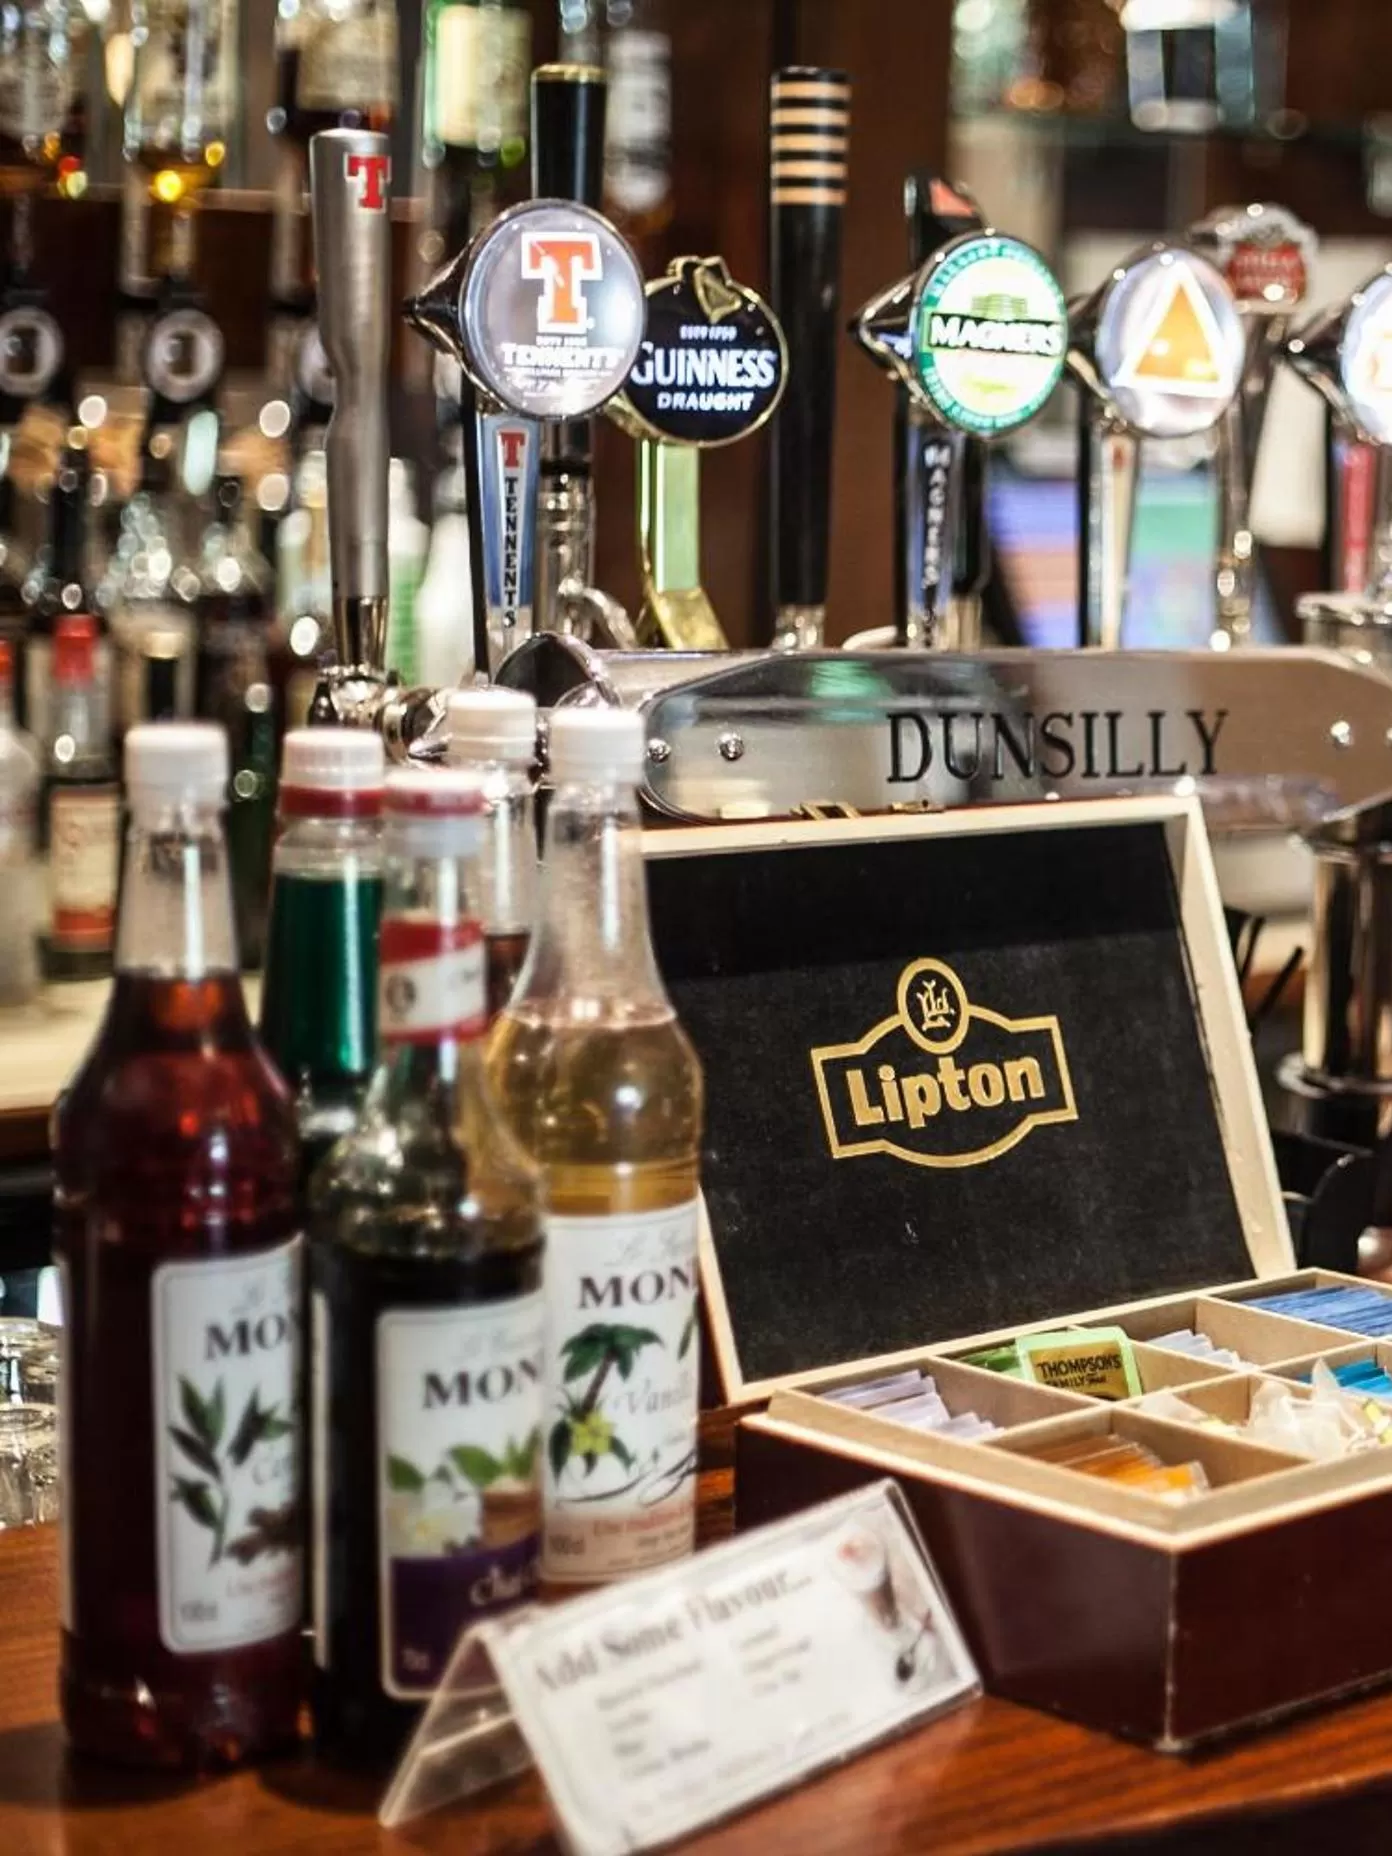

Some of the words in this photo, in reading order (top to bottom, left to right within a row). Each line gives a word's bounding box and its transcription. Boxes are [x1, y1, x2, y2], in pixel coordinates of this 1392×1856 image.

[346, 155, 391, 212] T
[521, 232, 602, 333] T
[630, 341, 777, 387] GUINNESS
[657, 391, 753, 412] DRAUGHT
[500, 432, 527, 468] T
[886, 708, 1228, 783] DUNSILLY
[846, 1056, 1045, 1129] Lipton
